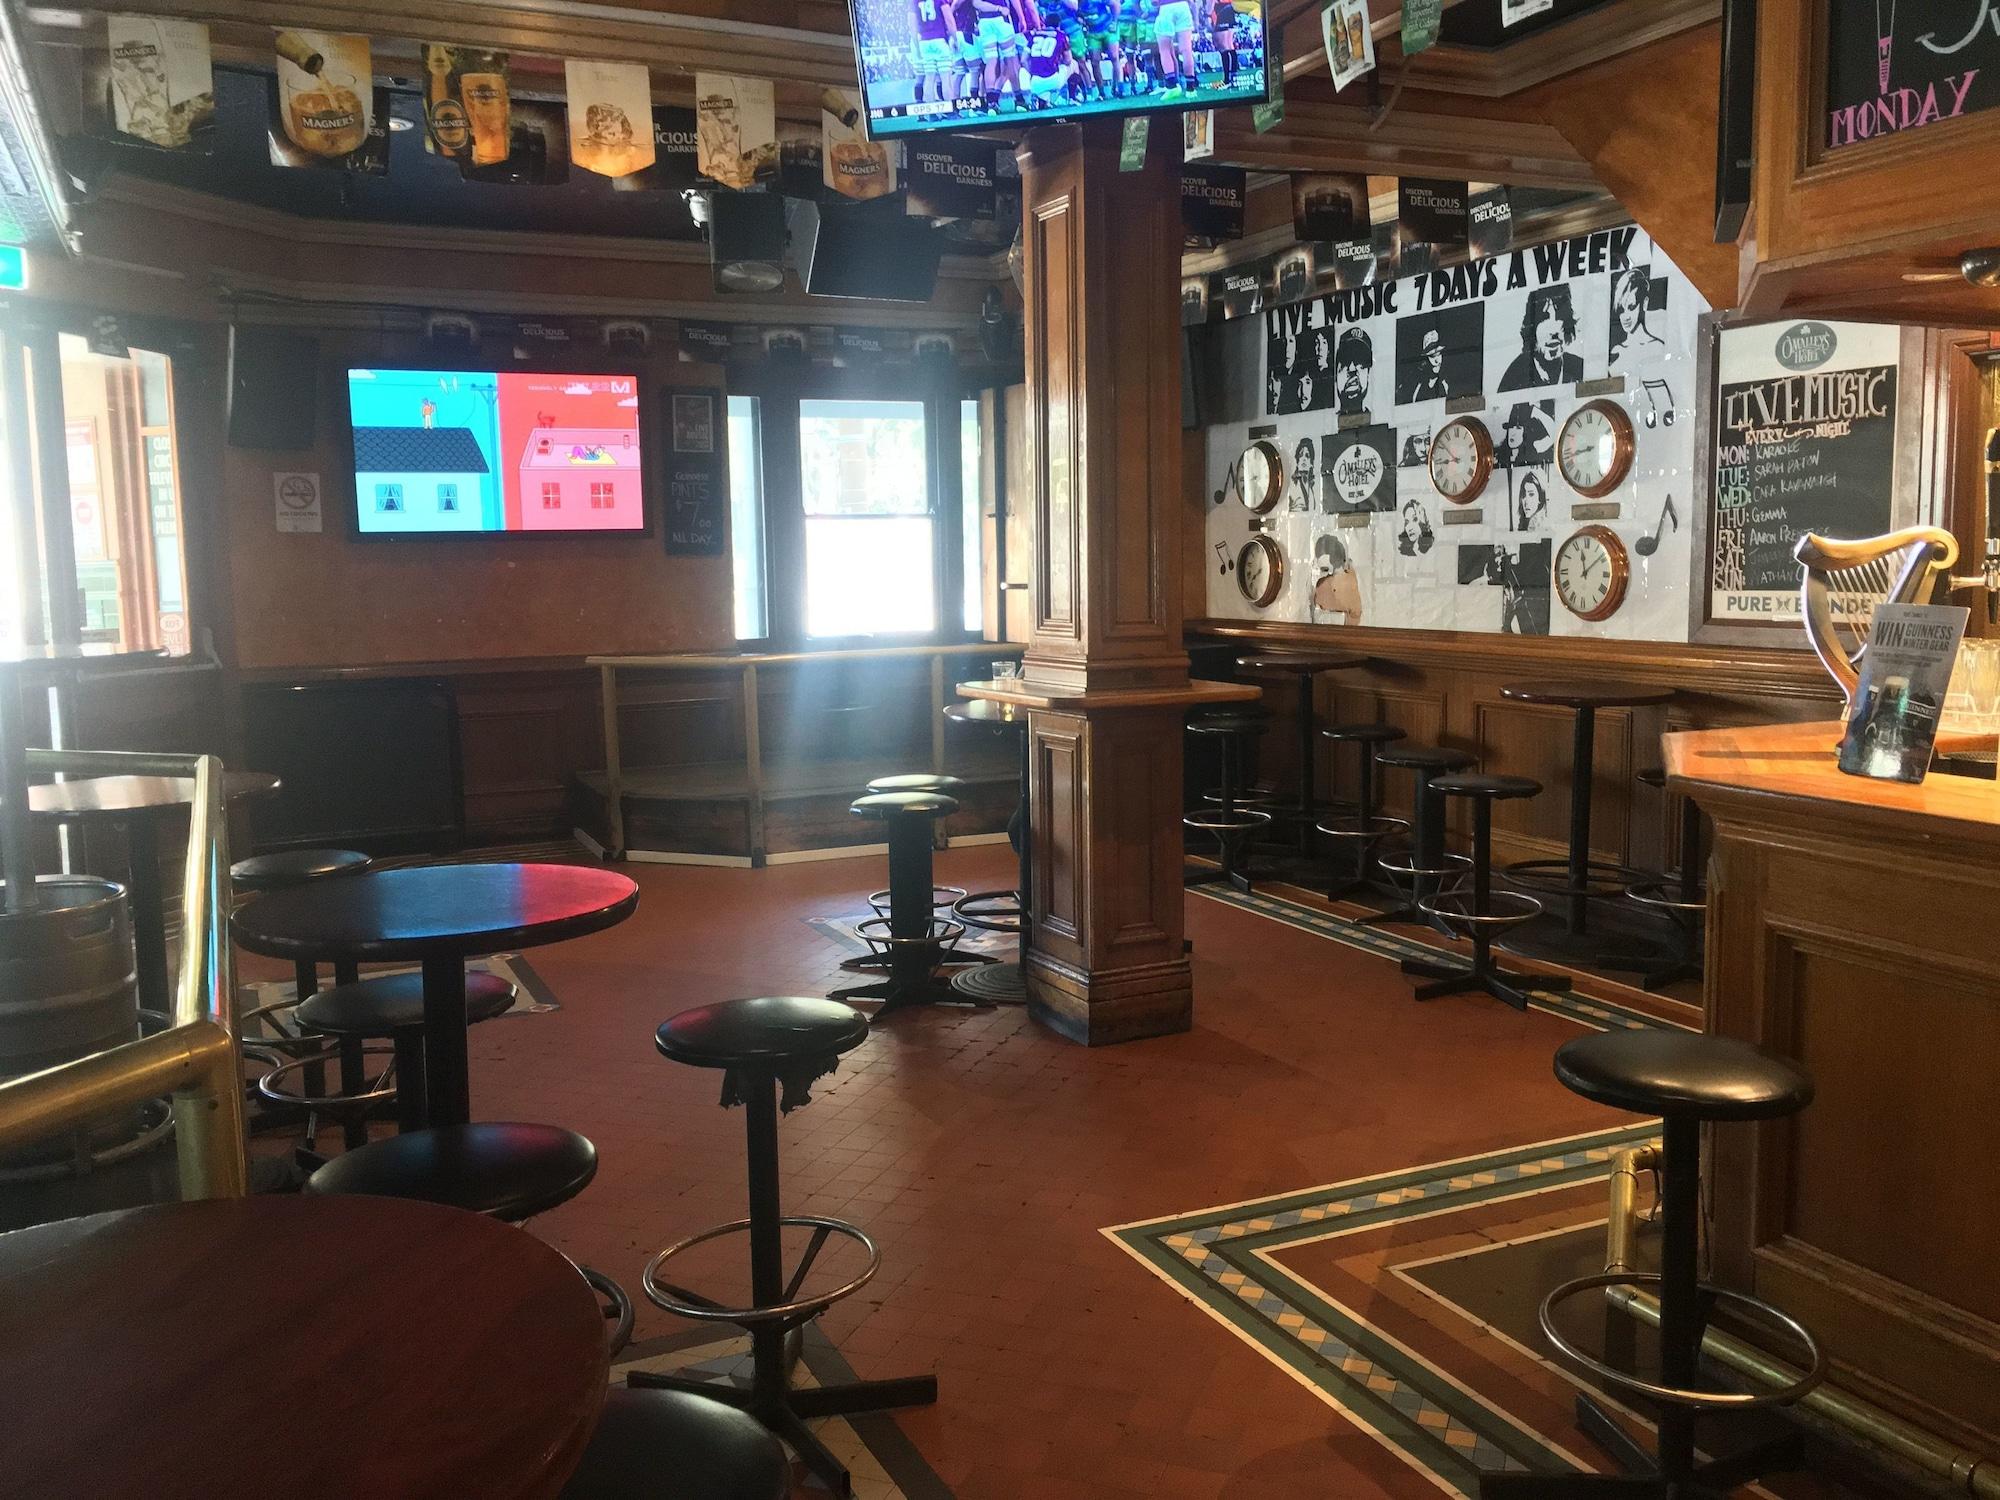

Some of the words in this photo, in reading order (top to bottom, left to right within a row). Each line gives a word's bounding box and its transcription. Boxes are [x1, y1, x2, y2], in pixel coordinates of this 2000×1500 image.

[114, 46, 156, 58] MAGNERS
[1031, 36, 1057, 58] 20
[890, 107, 899, 117] 6
[1830, 69, 1980, 148] MONDAY
[302, 113, 355, 128] MAGNERS
[916, 152, 953, 162] DISCOVER
[839, 162, 881, 176] MAGNERS
[923, 161, 987, 178] DELICIOUS
[956, 176, 993, 187] DARKNESS
[1410, 196, 1460, 209] DELICIOUS
[1338, 244, 1371, 258] DELICIOUS
[1227, 276, 1255, 291] DELICIOUS
[1265, 300, 1313, 342] LIVE
[1323, 280, 1398, 326] MUSIC
[1414, 272, 1428, 310] 7
[1431, 258, 1499, 308] DAYS
[1507, 251, 1527, 291] A
[1532, 226, 1638, 285] WEEK
[1794, 348, 1818, 364] HOTEL
[1726, 376, 1802, 433] LIVE
[1802, 368, 1889, 423] MUSIC
[1744, 427, 1784, 446] EVERY
[1813, 419, 1851, 438] NIGHT
[1719, 445, 1750, 466] MON:
[1754, 437, 1801, 460] KARAOKE
[1347, 474, 1370, 487] HOTEL
[1718, 466, 1750, 487] TUE:
[1754, 462, 1784, 482] SARAH
[671, 481, 710, 500] PINTS
[1717, 485, 1752, 508] WED:
[1717, 507, 1750, 529] THU:
[1751, 505, 1787, 523] GEMMA
[690, 533, 713, 546] DAY
[1718, 527, 1745, 549] FRI:
[1715, 546, 1745, 571] SAT:
[1714, 567, 1746, 592] SUN:
[1727, 596, 1772, 612] PURE
[1875, 620, 1906, 648] WIN
[1905, 622, 1954, 641] GUINNESS
[1902, 638, 1930, 651] WINTER
[1929, 640, 1950, 652] GEAR
